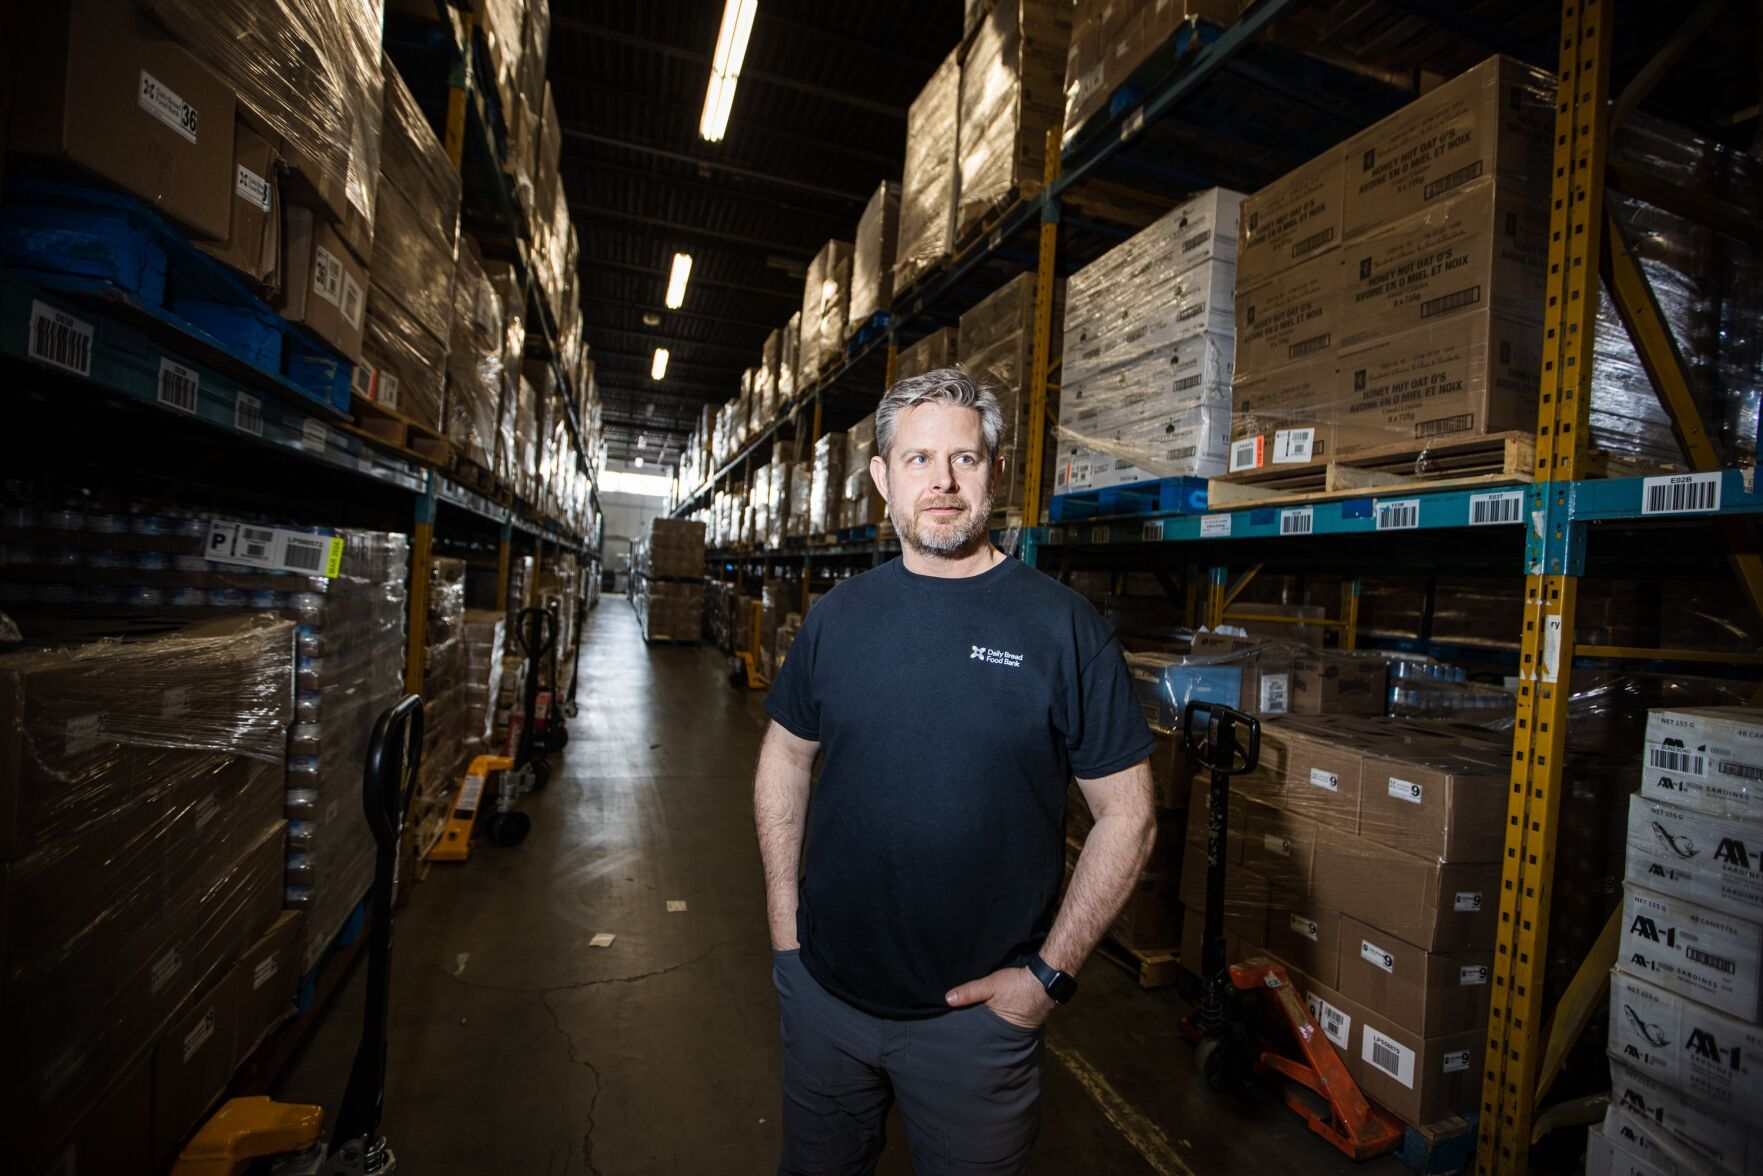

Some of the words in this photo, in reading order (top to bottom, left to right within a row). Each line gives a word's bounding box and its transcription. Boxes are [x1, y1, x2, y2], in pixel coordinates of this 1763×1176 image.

[182, 104, 197, 131] 36
[1434, 142, 1445, 157] ET
[1448, 131, 1471, 151] NOIX
[1401, 147, 1419, 163] NUT
[1420, 138, 1437, 154] OAT
[1369, 270, 1396, 286] HONEY
[1398, 262, 1416, 276] NUT
[1418, 255, 1435, 269] OAT
[1386, 277, 1397, 292] EN
[1408, 267, 1429, 283] MIEL
[1432, 262, 1443, 276] ET
[1445, 254, 1470, 271] NOIX
[1363, 385, 1391, 401] HONEY
[1392, 380, 1409, 394] NUT
[1411, 376, 1429, 389] OAT
[1431, 372, 1447, 385] O'S
[1380, 396, 1391, 408] EN
[1401, 390, 1422, 403] MIEL
[1425, 386, 1436, 398] ET
[1438, 380, 1463, 396] NOIX
[1670, 476, 1692, 484] E02B
[211, 533, 226, 549] P
[1551, 621, 1560, 630] ry
[987, 649, 1004, 659] Daily
[1004, 651, 1024, 661] Bread
[986, 655, 1003, 664] Food
[1003, 658, 1020, 668] Bank
[1330, 776, 1337, 787] 9
[1411, 785, 1420, 797] 9
[1706, 786, 1750, 800] SARDINES
[1652, 808, 1663, 816] NET
[1665, 810, 1677, 818] 155
[1283, 841, 1290, 852] 9
[1473, 895, 1481, 906] 9
[1634, 897, 1647, 905] NET
[1648, 900, 1660, 909] 155
[1309, 923, 1316, 934] 9
[1384, 955, 1392, 967] 9
[1479, 968, 1487, 979] 9
[1678, 968, 1718, 989] SARDINES
[1627, 985, 1640, 994] NET
[1641, 990, 1653, 1000] 155
[1461, 1052, 1469, 1064] 9
